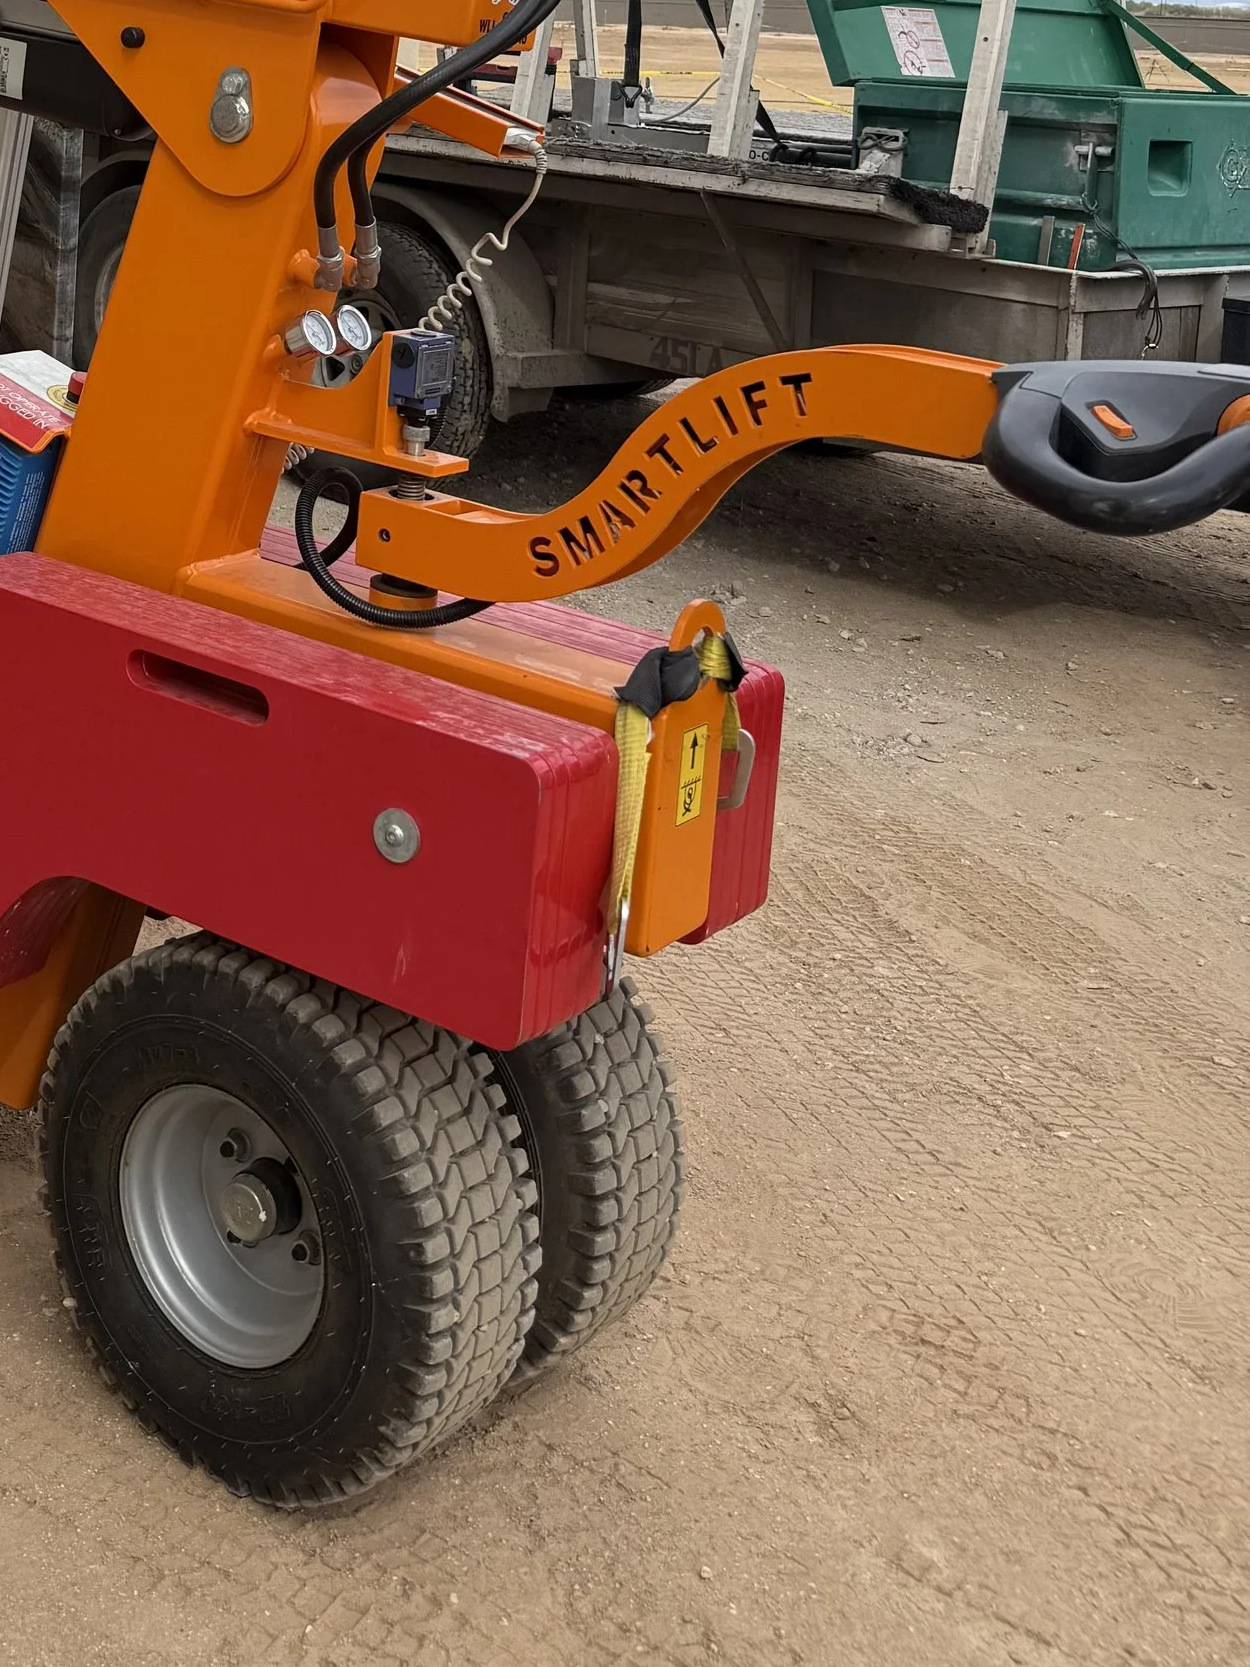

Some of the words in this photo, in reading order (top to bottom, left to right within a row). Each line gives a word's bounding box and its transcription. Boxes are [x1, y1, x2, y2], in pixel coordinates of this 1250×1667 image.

[9, 392, 62, 425] OPERATE
[33, 417, 52, 430] IN
[528, 372, 813, 577] SMARTLIFT
